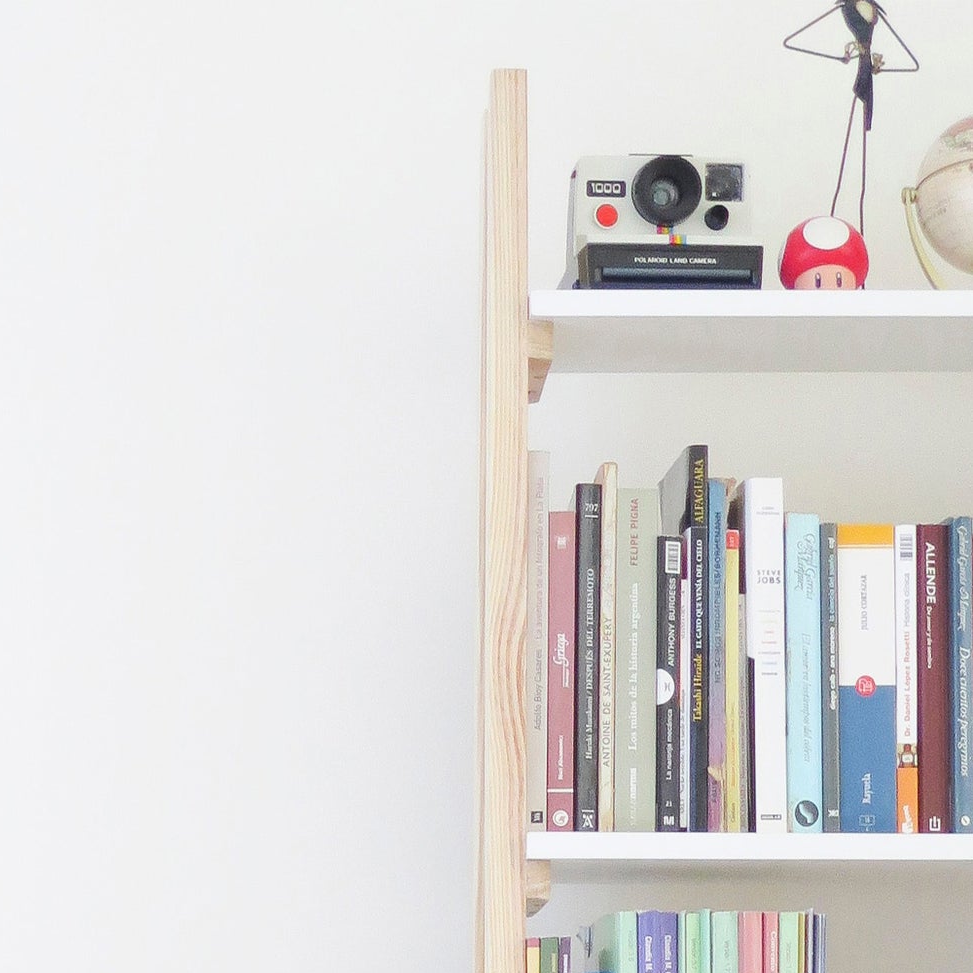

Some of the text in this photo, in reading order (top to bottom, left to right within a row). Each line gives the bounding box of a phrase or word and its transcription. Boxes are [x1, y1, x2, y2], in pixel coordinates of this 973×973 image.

[591, 183, 621, 193] 1000
[695, 459, 703, 523] ALFAGUARA
[630, 534, 638, 565] FELIPE
[926, 543, 936, 603] ALLENDE
[586, 569, 595, 626] TERREMOTO
[696, 640, 702, 648] EL
[585, 650, 594, 689] DESPUÉS
[628, 583, 639, 750] Los mitos de la historia argentina
[693, 655, 702, 721] Takashi Hiraide
[603, 703, 610, 714] DE
[958, 647, 970, 776] Doce cuentos peregrinos
[666, 771, 672, 780] La
[862, 774, 873, 803] Rayuela
